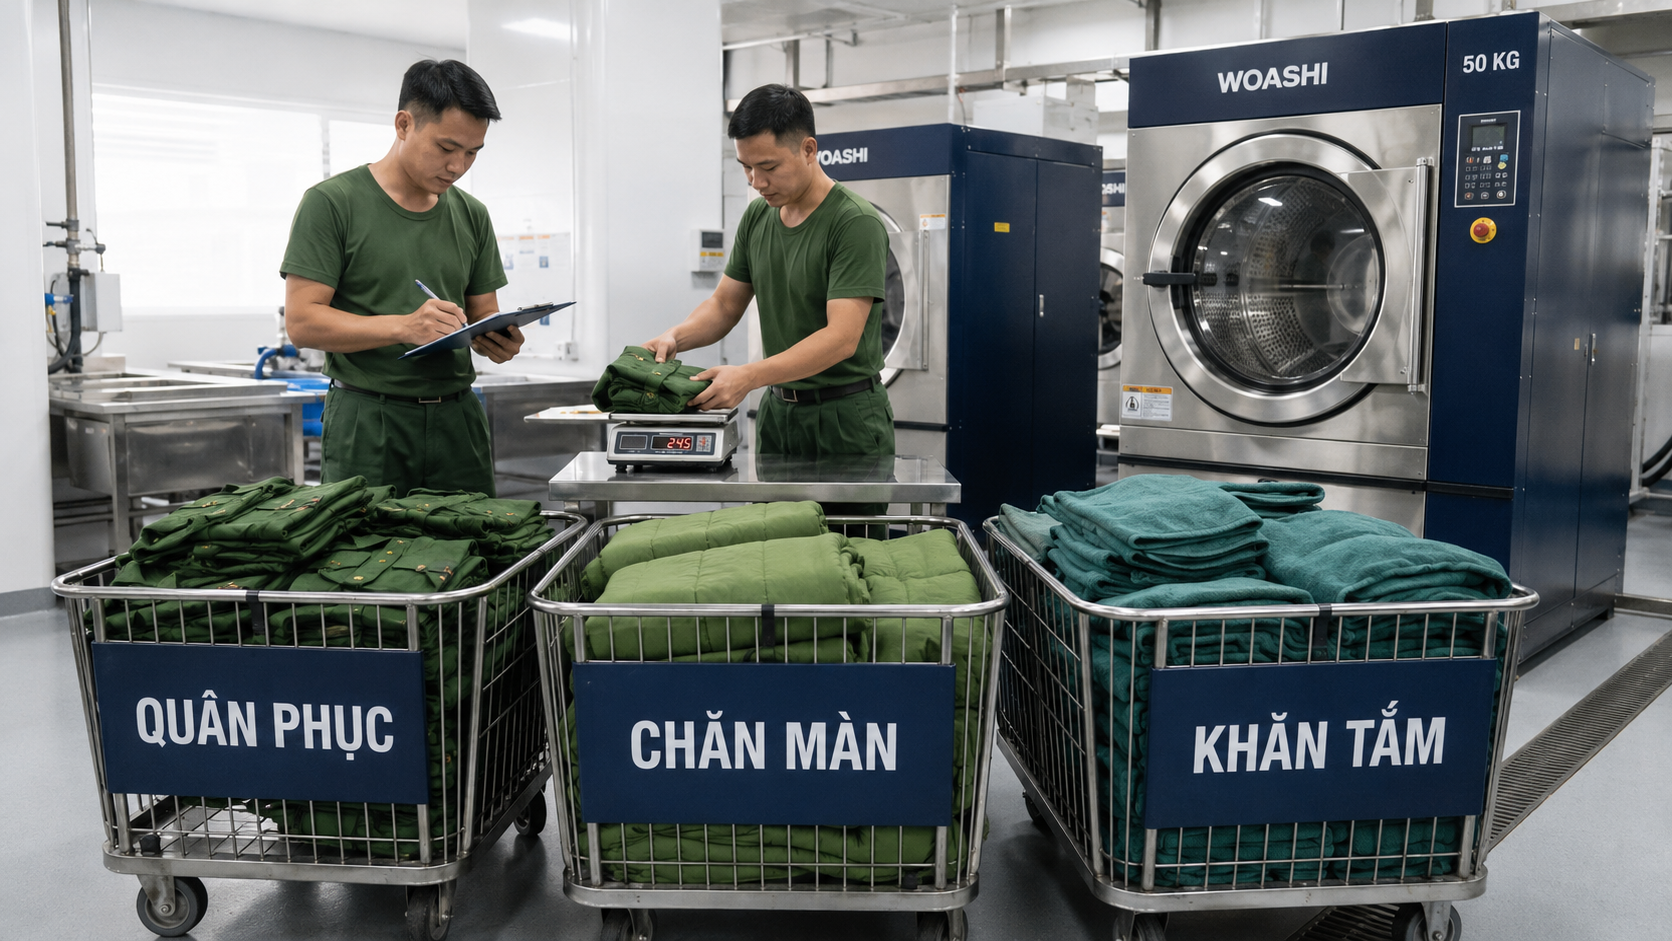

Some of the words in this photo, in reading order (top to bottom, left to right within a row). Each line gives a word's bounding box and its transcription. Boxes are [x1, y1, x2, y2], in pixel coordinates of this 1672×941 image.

[1217, 61, 1329, 94] WOASHI
[1462, 53, 1488, 74] 50
[1492, 50, 1521, 71] KG
[667, 437, 691, 449] 245
[136, 689, 258, 748] QUÂN
[273, 702, 395, 761] PHỤC
[630, 710, 767, 770] CHĂN
[786, 710, 897, 771] MÀN
[1193, 712, 1328, 773] KHĂN
[1345, 700, 1446, 767] TẮM
